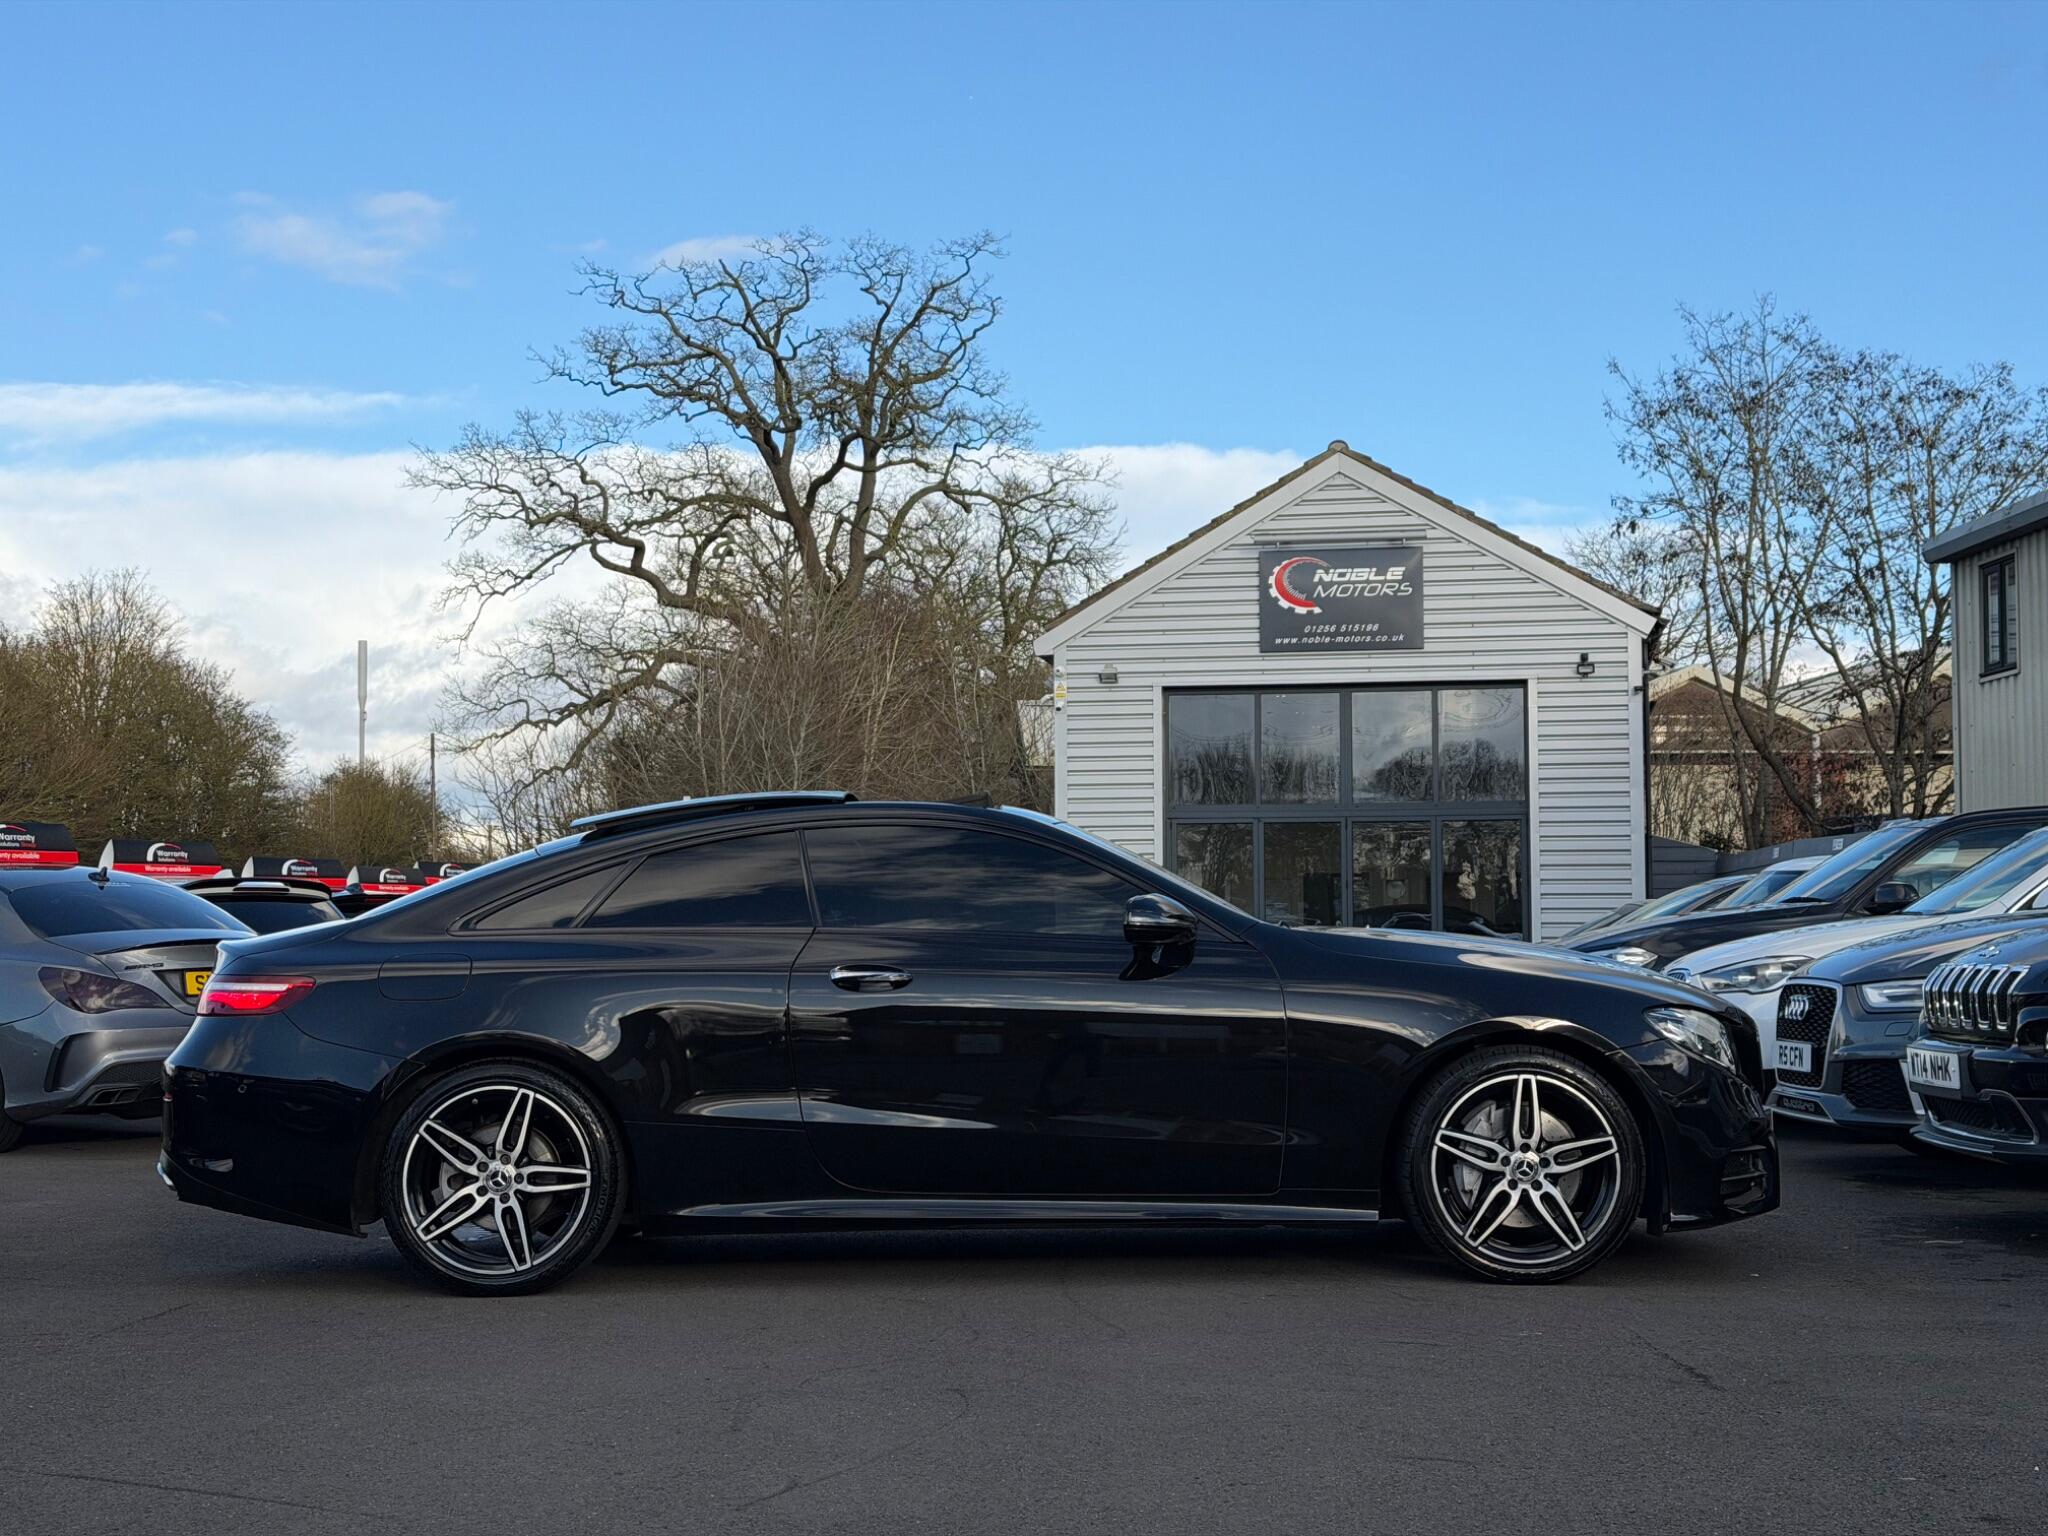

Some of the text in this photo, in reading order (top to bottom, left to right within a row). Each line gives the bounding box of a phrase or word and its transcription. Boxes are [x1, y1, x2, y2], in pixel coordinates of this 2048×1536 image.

[1313, 566, 1406, 583] NOBLE
[1313, 582, 1413, 598] MOTORS
[1304, 624, 1337, 633] 01256
[1274, 633, 1405, 644] www.noble-motors.co.uk
[156, 850, 188, 859] Warranty
[1779, 1045, 1804, 1068] R5 CFN
[1930, 1054, 1952, 1081] NHK
